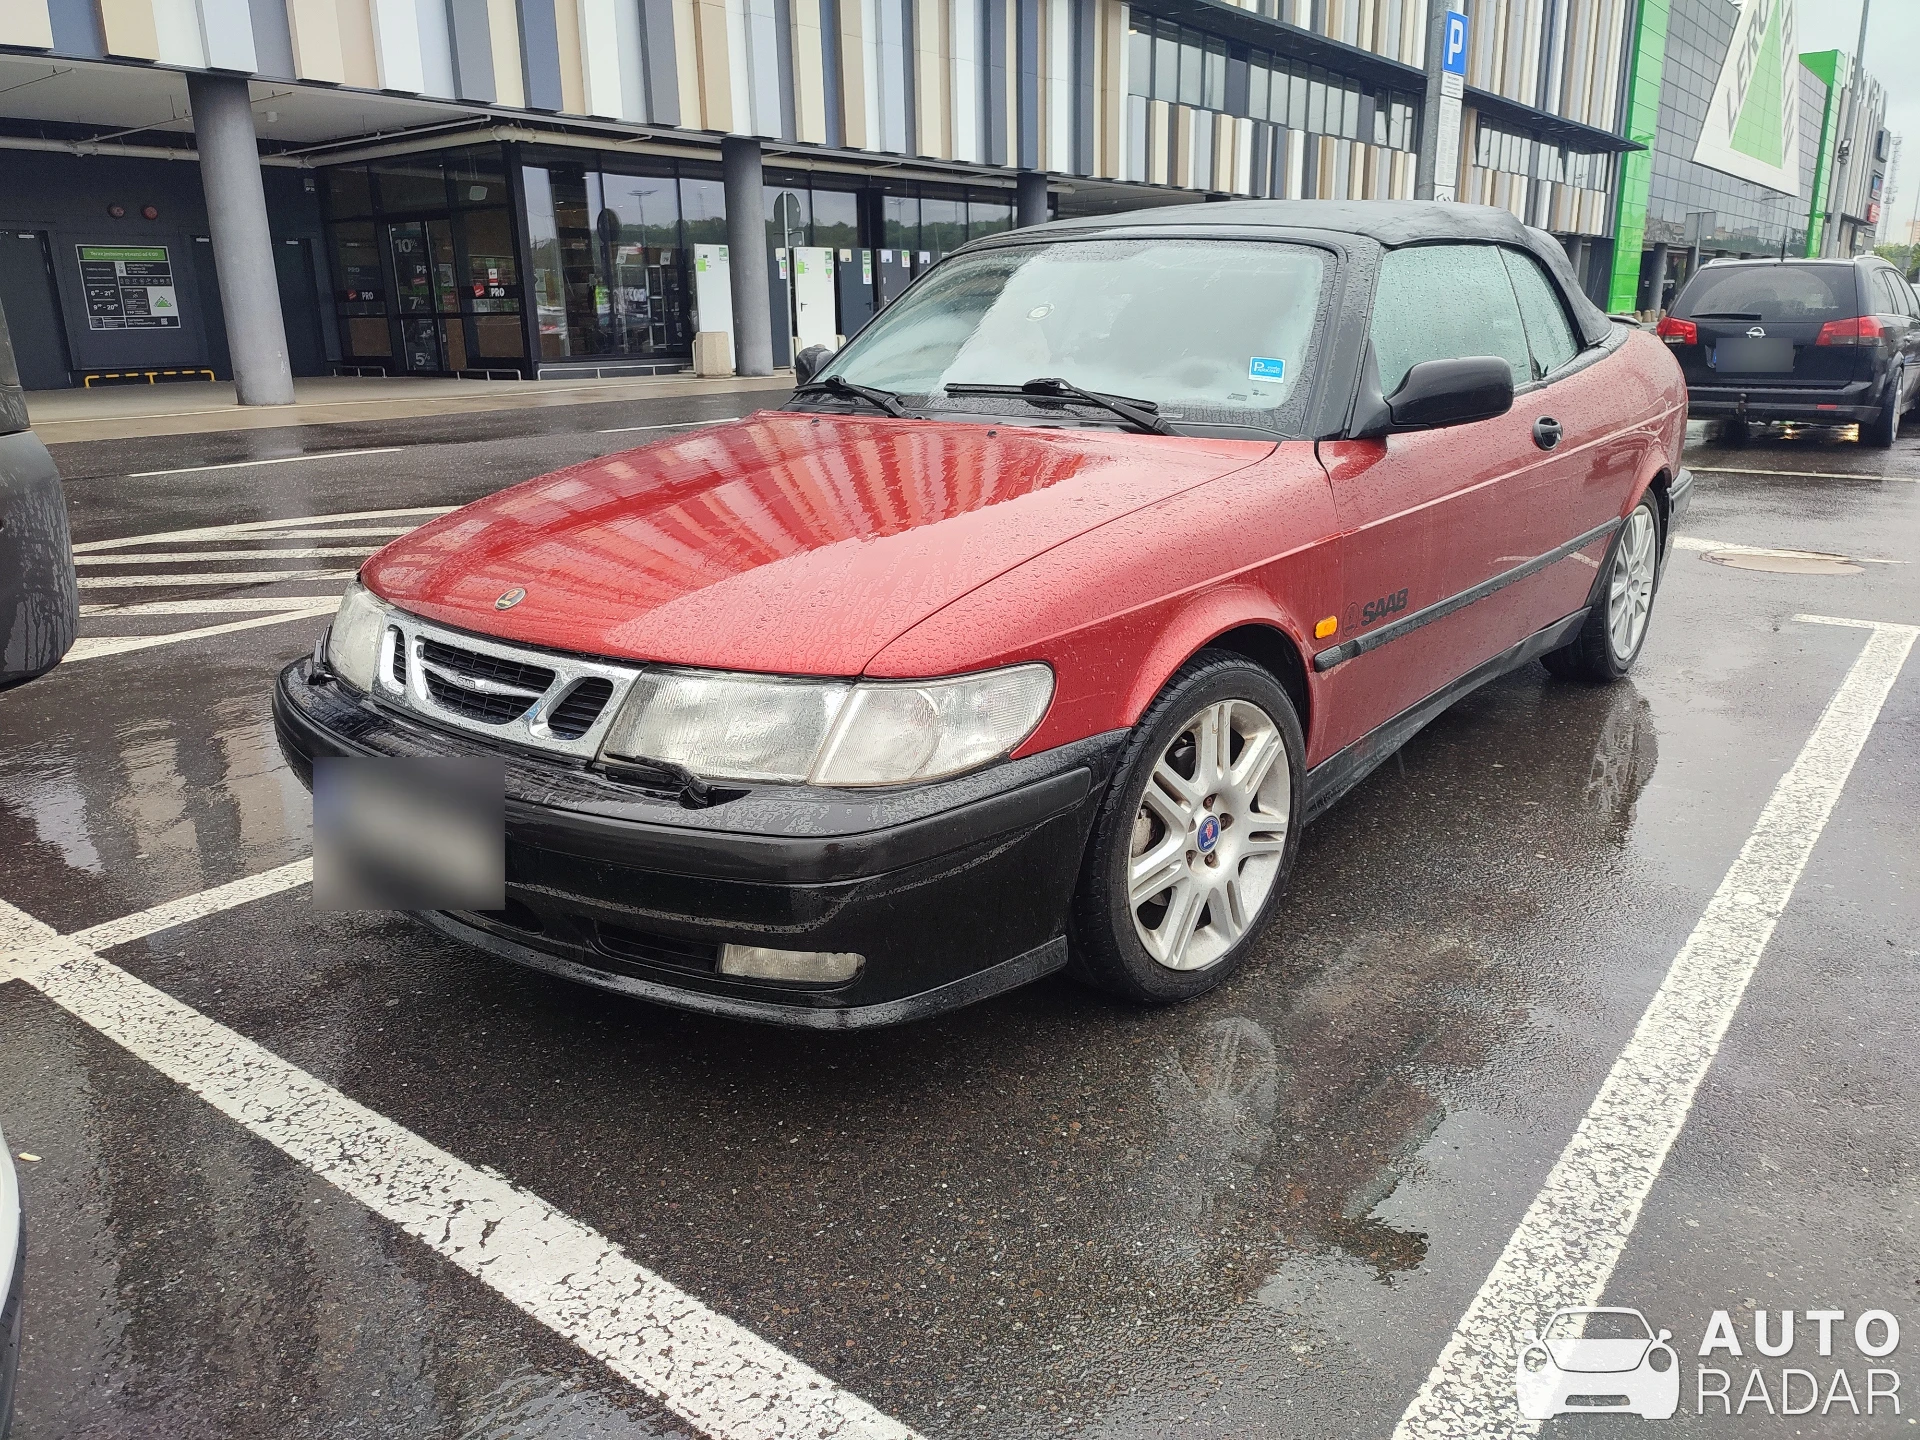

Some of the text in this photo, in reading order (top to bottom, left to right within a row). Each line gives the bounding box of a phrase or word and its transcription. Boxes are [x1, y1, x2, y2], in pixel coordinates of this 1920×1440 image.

[1448, 19, 1464, 65] P
[361, 291, 374, 300] PRO
[490, 287, 506, 298] PRO
[1361, 587, 1409, 627] SAAB
